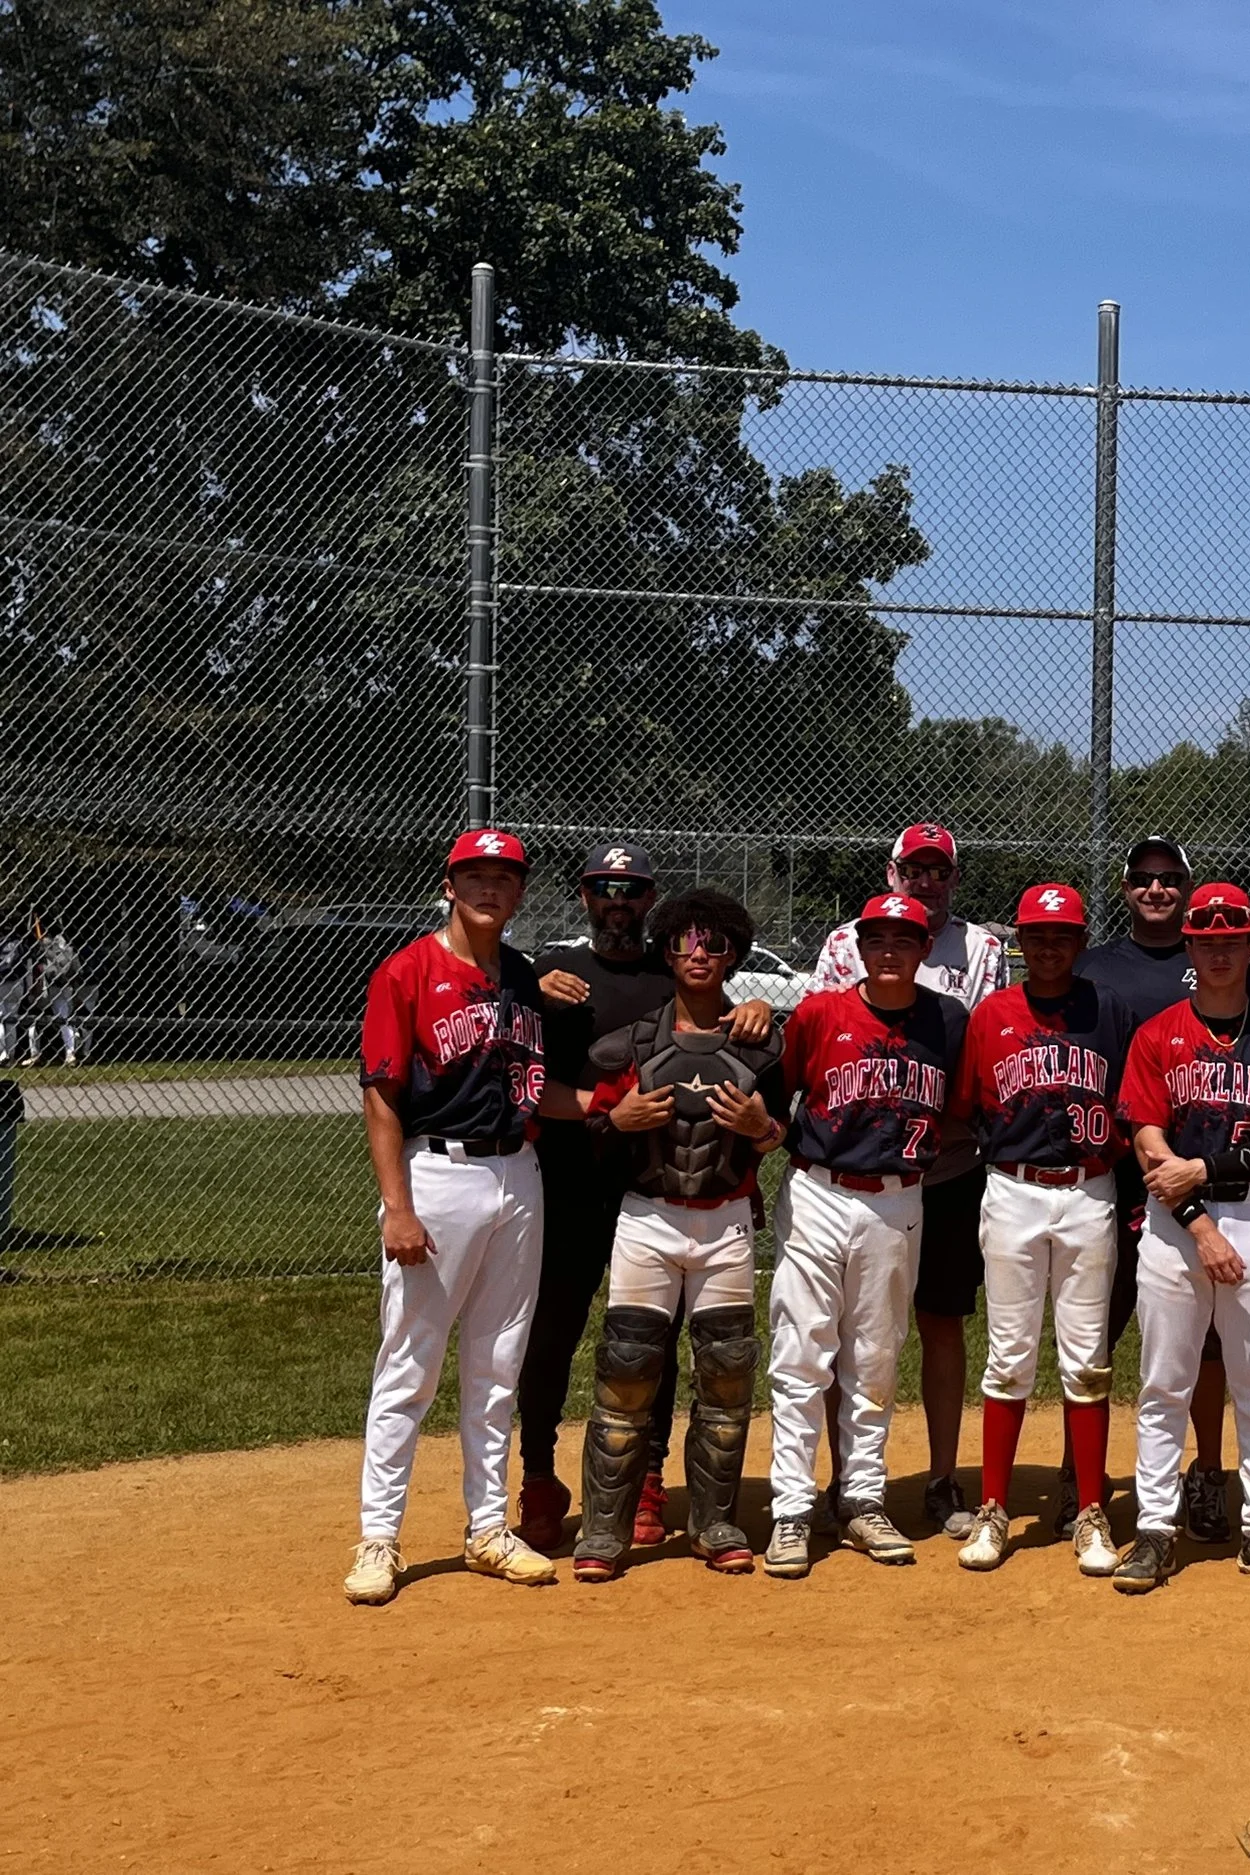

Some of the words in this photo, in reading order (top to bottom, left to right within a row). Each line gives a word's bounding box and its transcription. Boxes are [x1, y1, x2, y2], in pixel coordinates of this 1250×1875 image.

[825, 1058, 946, 1112] ROCKLAND
[993, 1044, 1108, 1104] ROCKLAND
[902, 1118, 928, 1159] 7
[1066, 1103, 1109, 1145] 30
